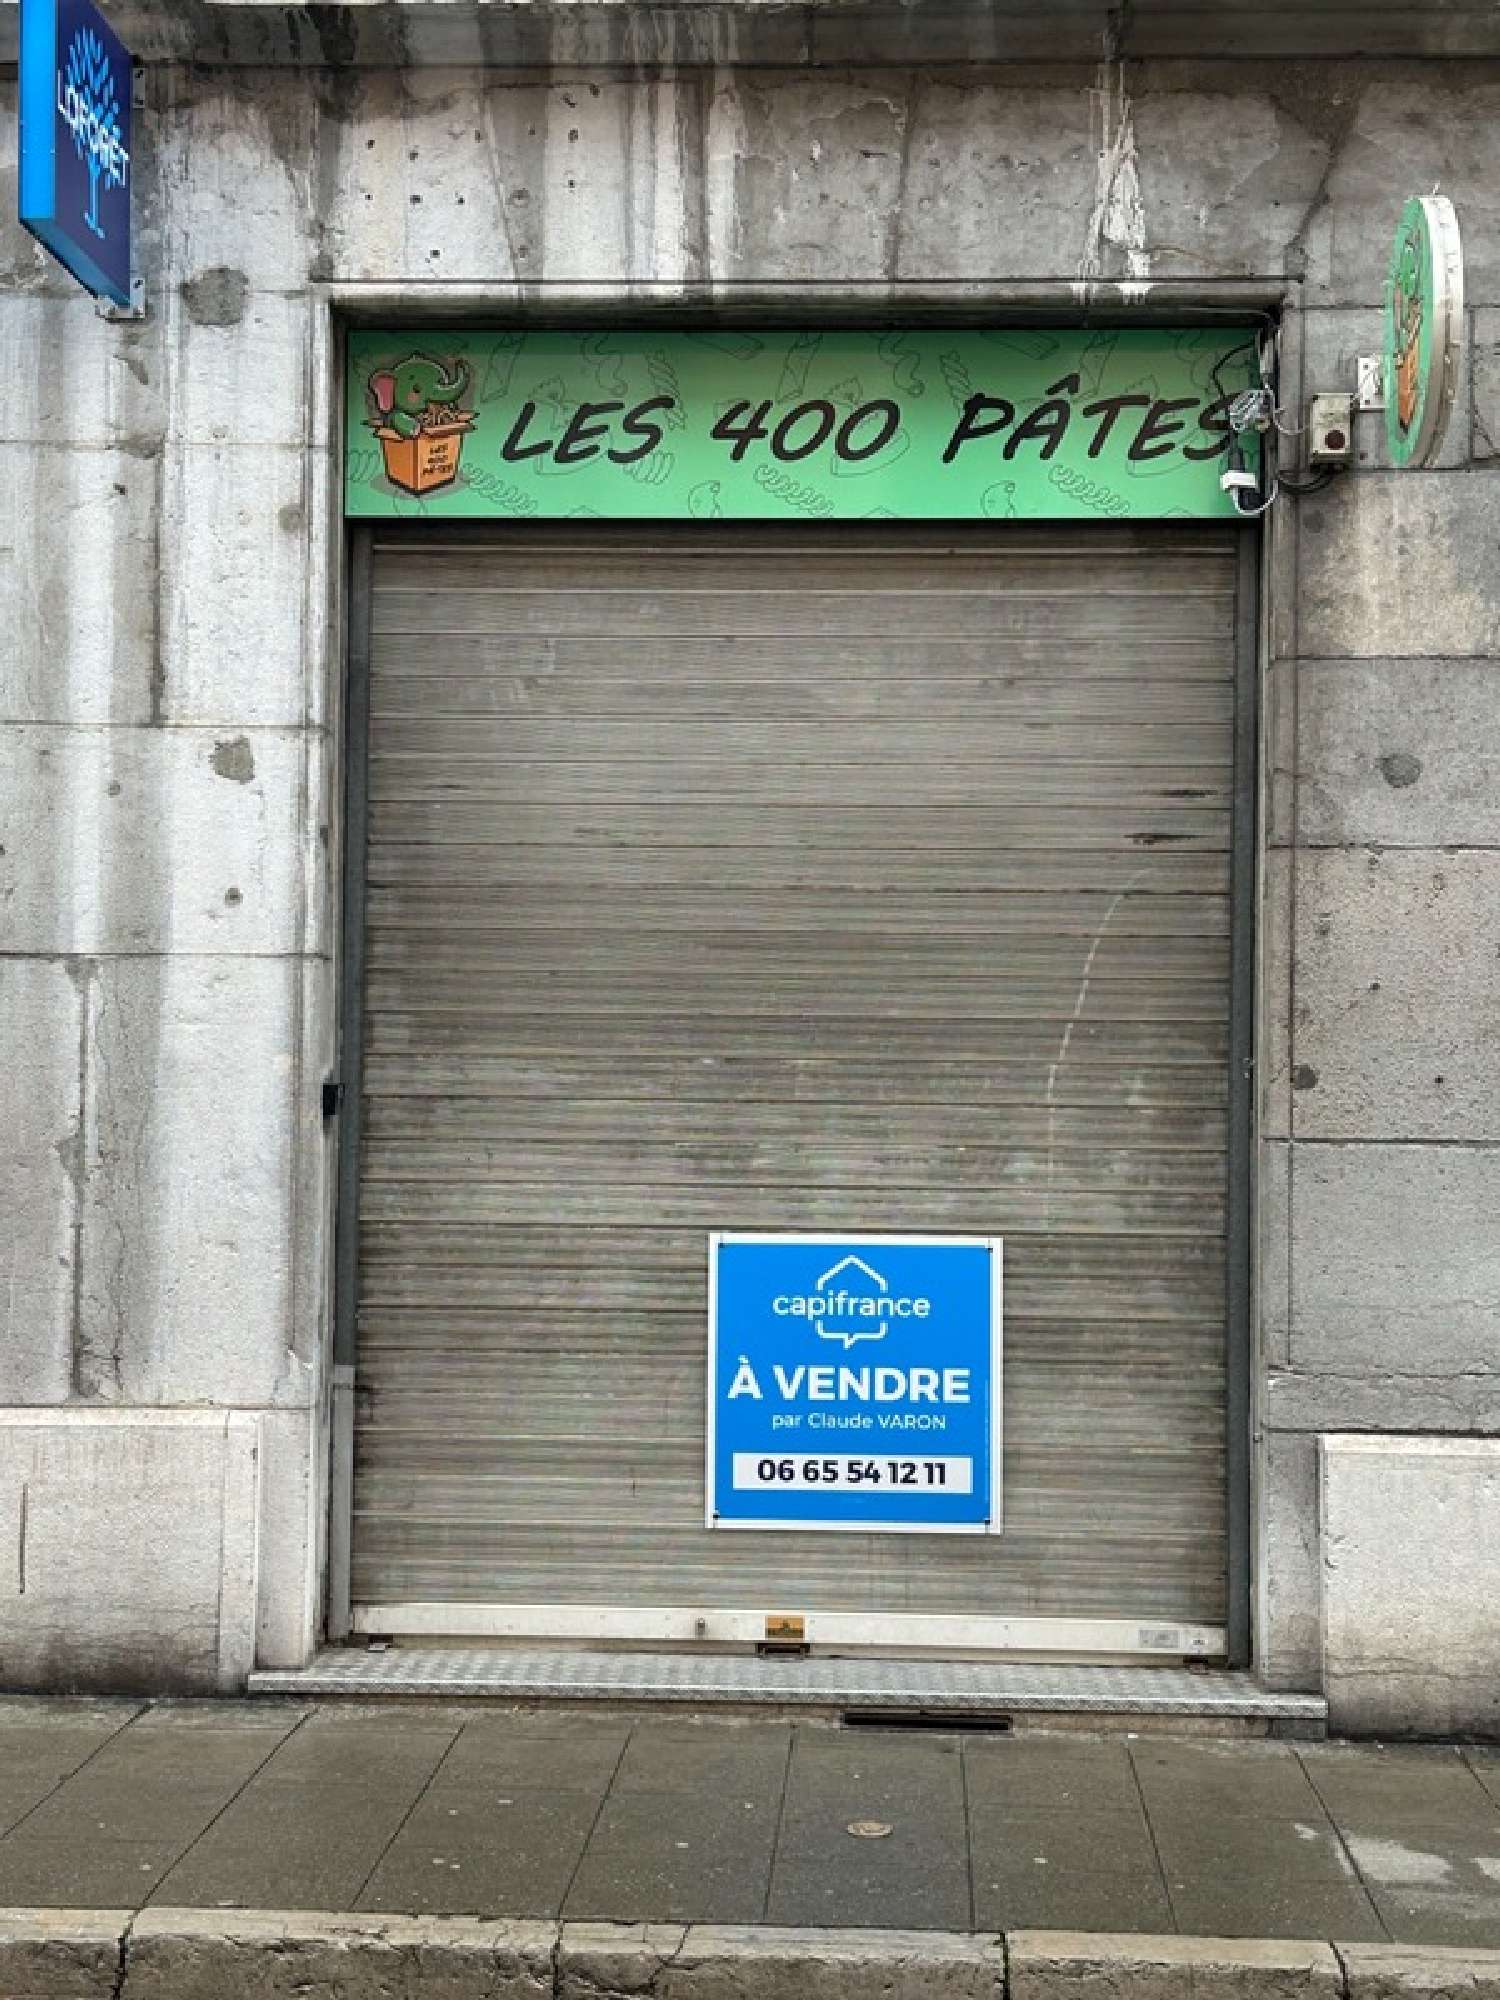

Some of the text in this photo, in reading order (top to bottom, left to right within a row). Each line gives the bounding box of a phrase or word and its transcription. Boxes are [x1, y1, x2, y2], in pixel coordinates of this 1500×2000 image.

[501, 397, 675, 463] LES
[710, 399, 899, 462] 400
[942, 373, 1238, 463] PÂTES
[772, 1290, 930, 1320] capifrance
[727, 1355, 971, 1403] À VENDRE
[772, 1412, 946, 1430] par Claude VARON
[757, 1459, 946, 1485] 06 65 54 12 11
